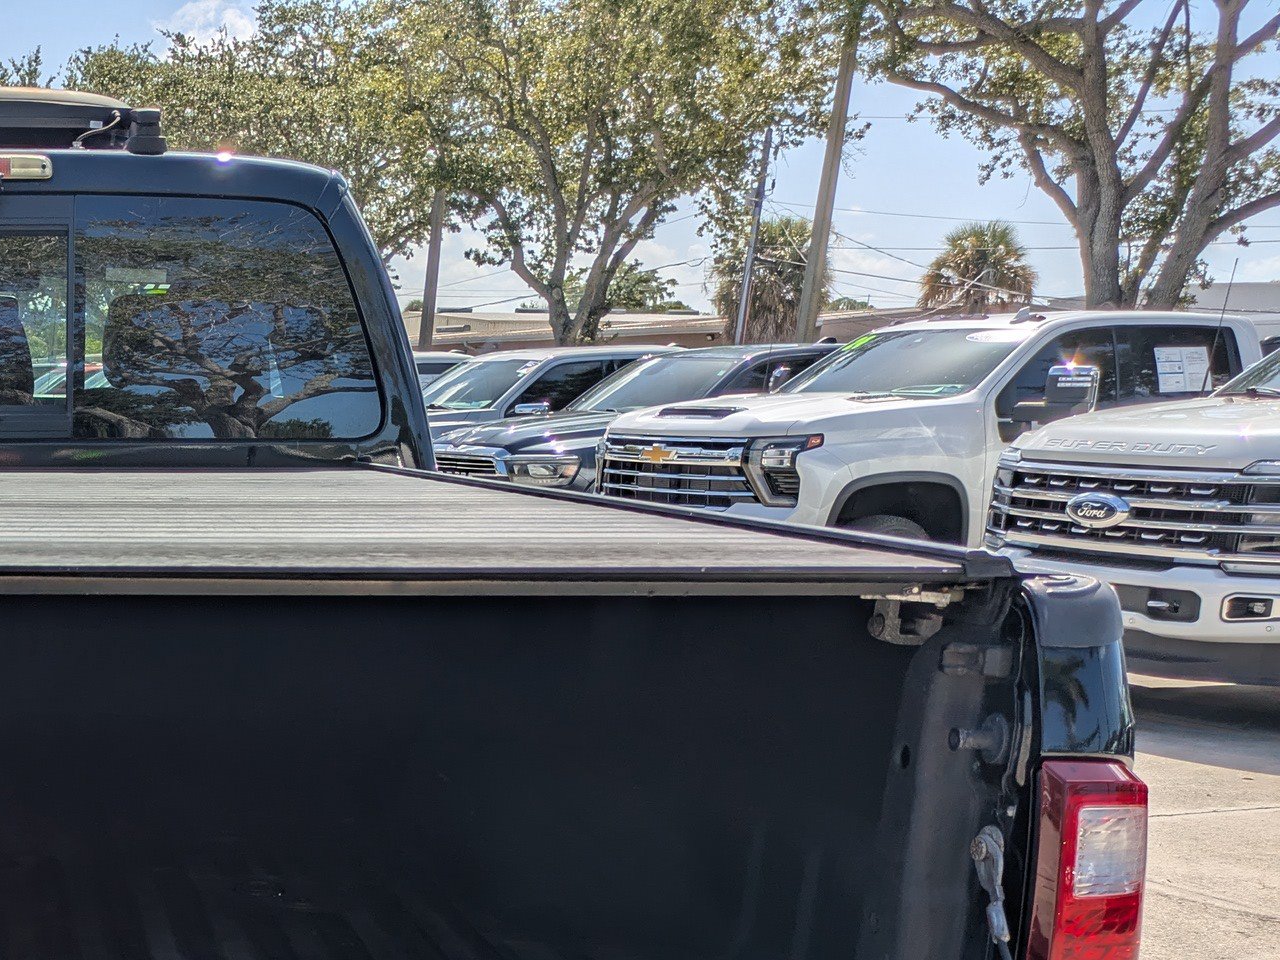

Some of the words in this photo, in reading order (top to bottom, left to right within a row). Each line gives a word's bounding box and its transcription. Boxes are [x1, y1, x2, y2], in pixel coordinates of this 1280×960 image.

[1044, 438, 1128, 452] SUPER
[1131, 441, 1218, 455] DUTY
[1077, 501, 1107, 519] Ford
